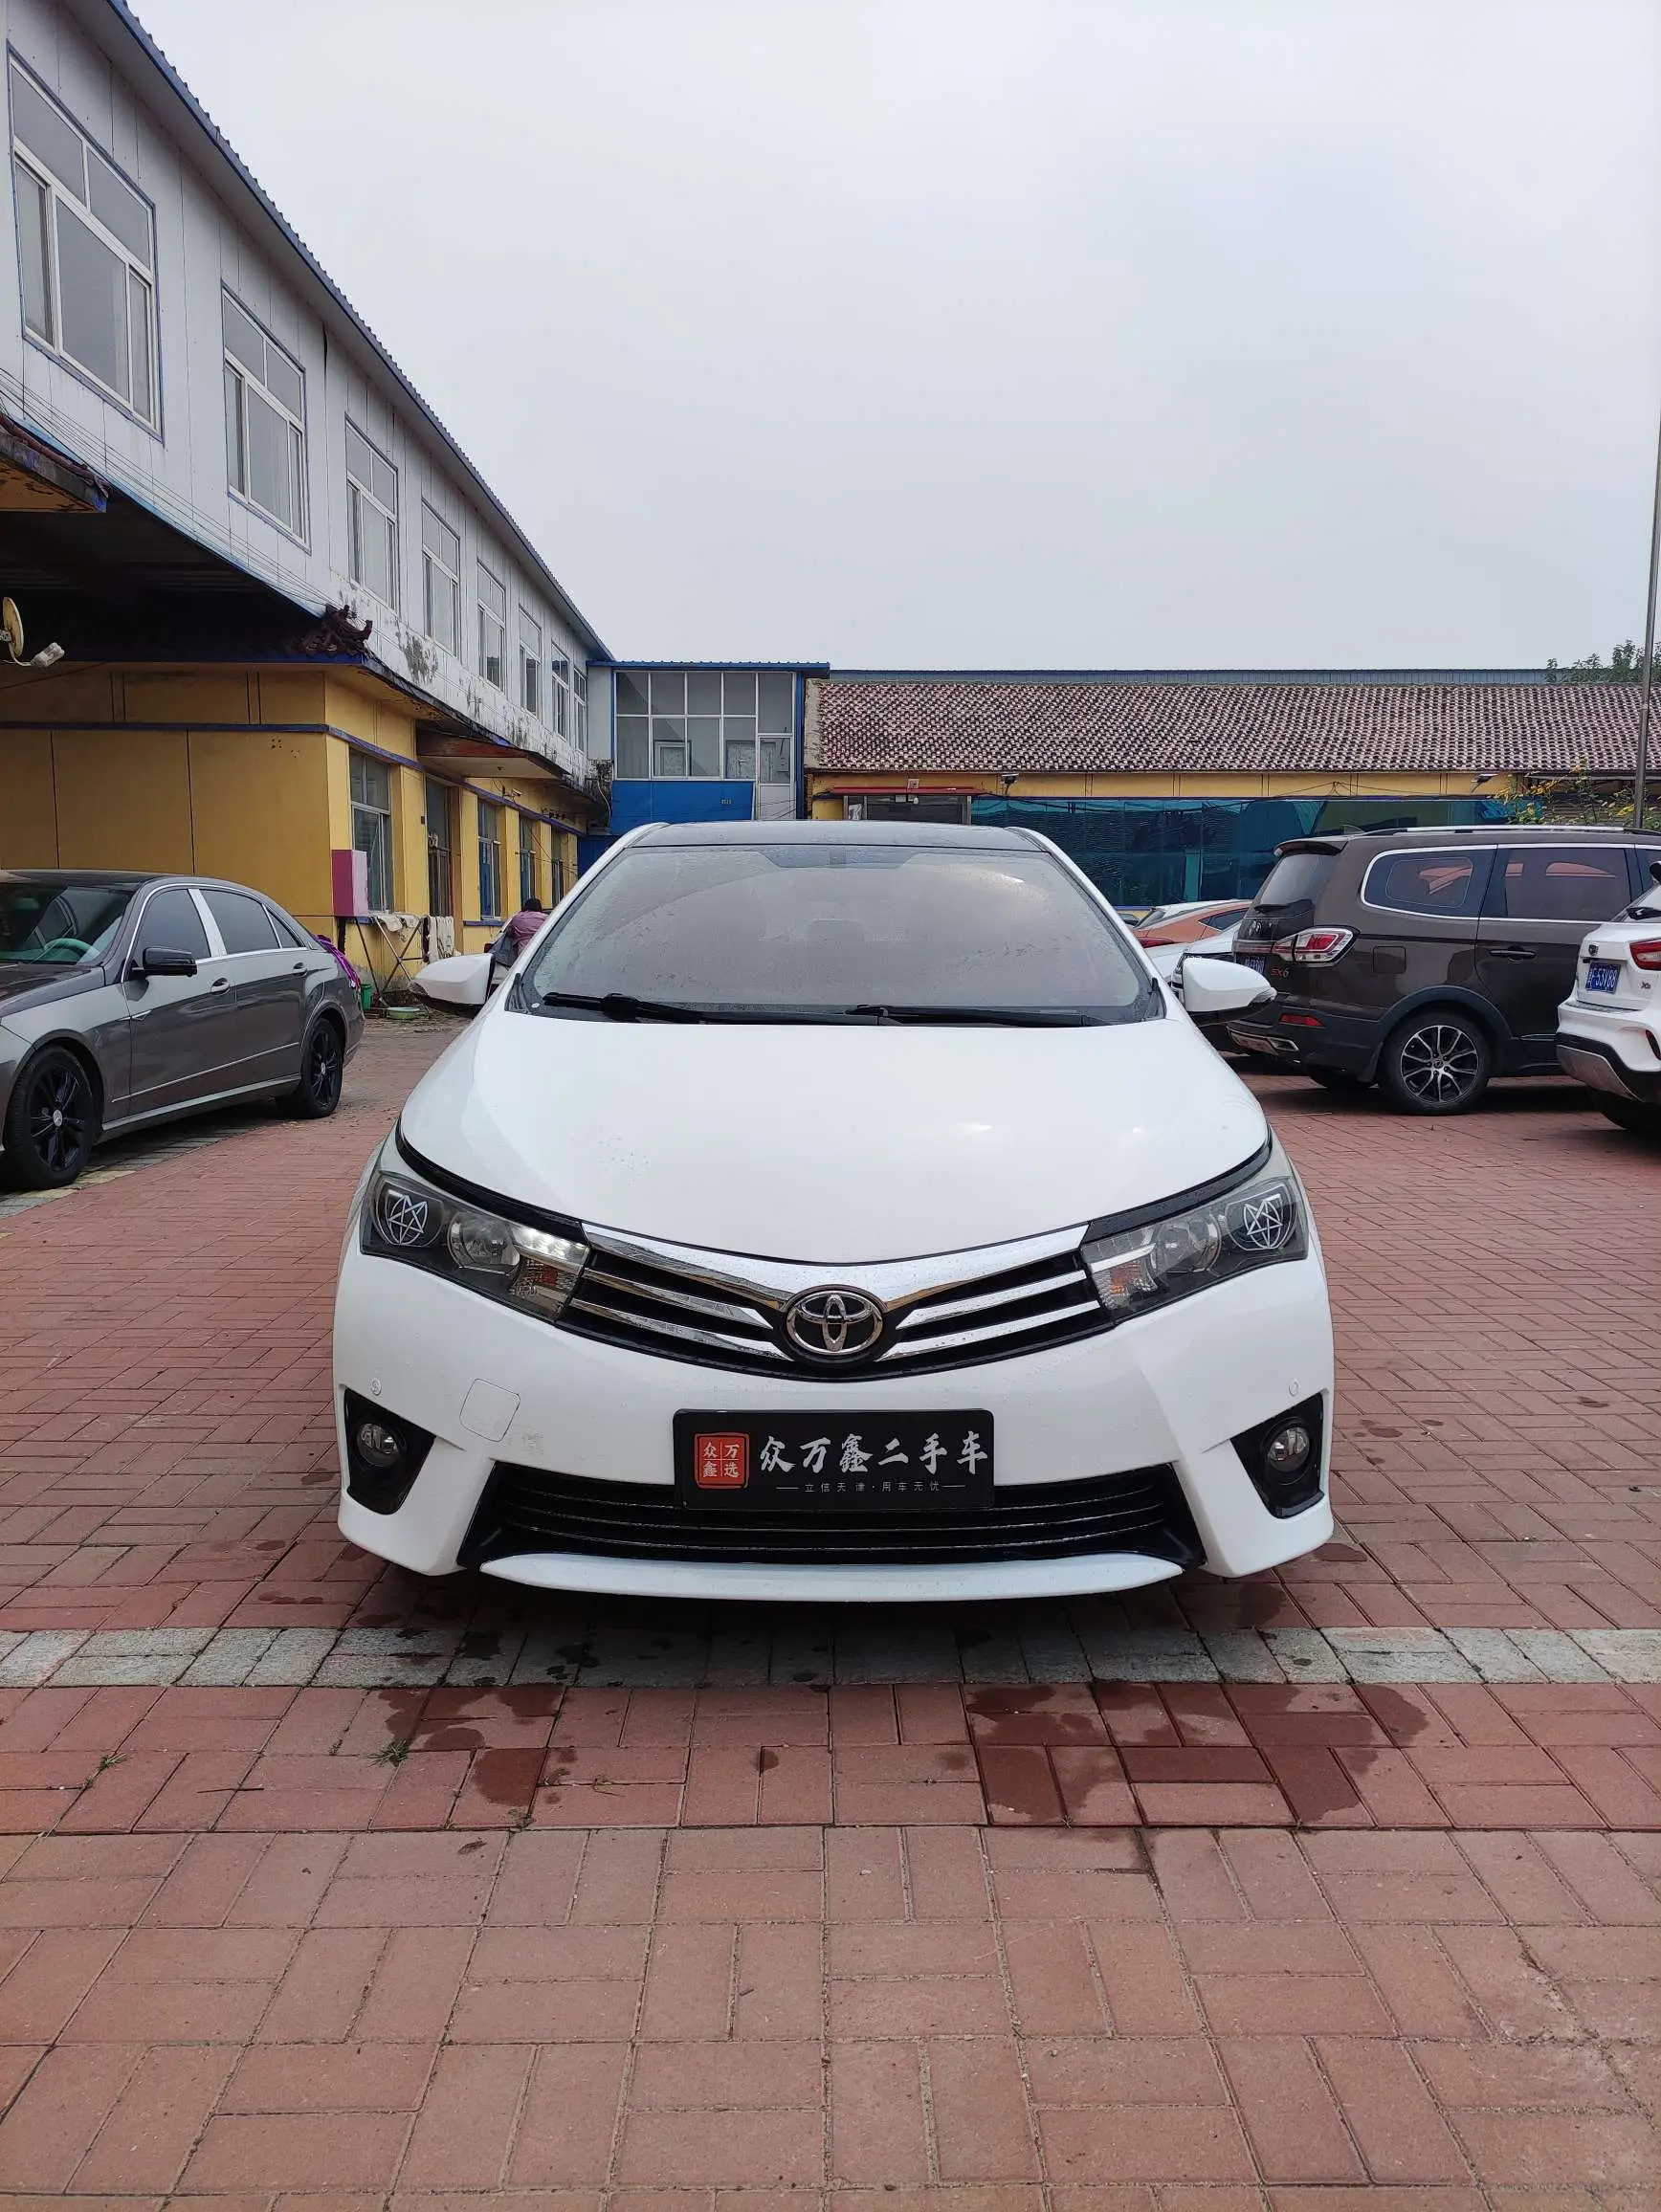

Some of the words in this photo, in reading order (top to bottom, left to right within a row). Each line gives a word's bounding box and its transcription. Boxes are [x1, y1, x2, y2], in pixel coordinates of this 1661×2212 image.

[1270, 967, 1290, 979] SX6
[760, 1431, 988, 1474] 众万鑫二手车
